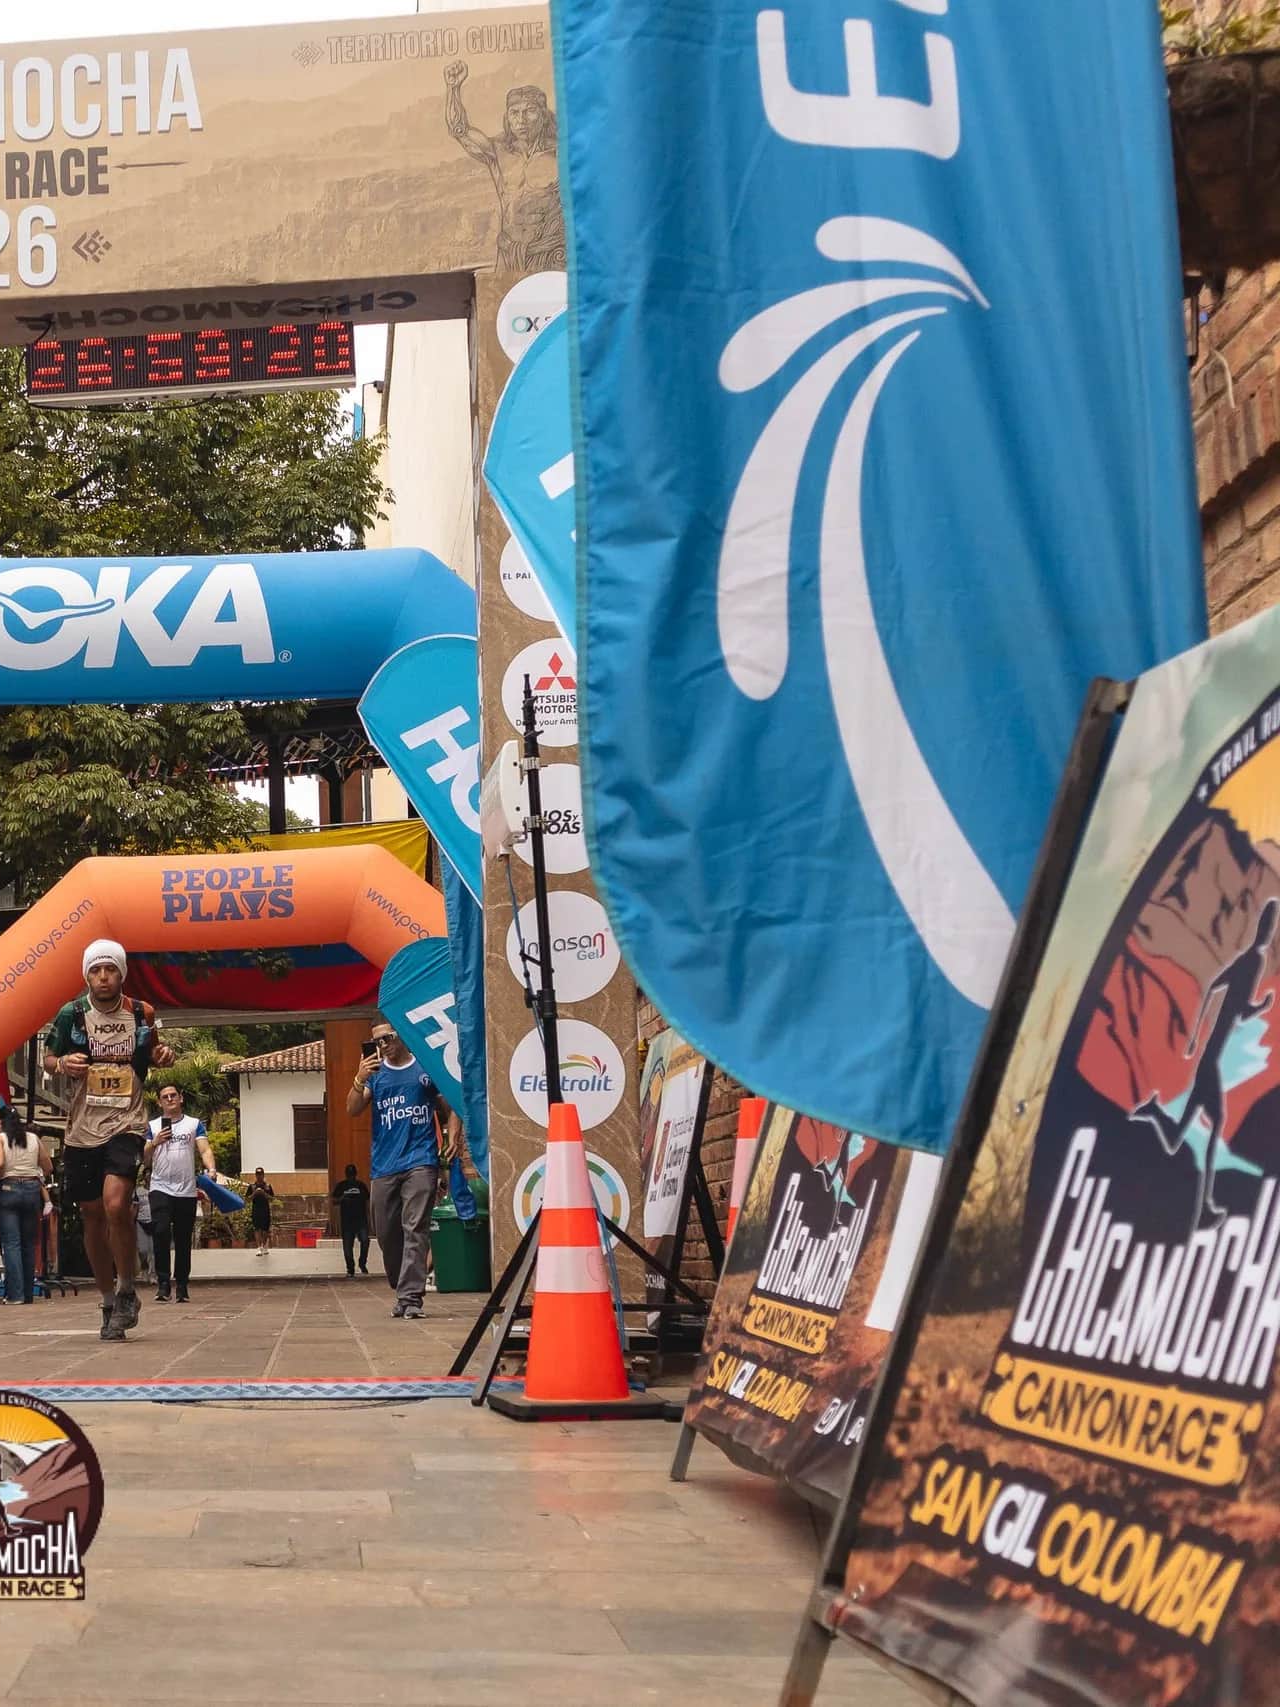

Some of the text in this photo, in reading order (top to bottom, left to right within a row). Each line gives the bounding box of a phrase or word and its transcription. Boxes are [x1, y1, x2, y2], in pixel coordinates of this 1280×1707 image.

[326, 21, 545, 65] TERRITORIO GUANE
[5, 145, 110, 199] RACE
[536, 695, 576, 704] TSUBIS
[400, 705, 482, 835] HO
[1211, 726, 1258, 786] TRAIL
[161, 865, 294, 892] PEOPLE
[162, 888, 296, 923] PLAYS
[367, 888, 429, 938] www.peo
[521, 932, 604, 958] Inasan
[577, 949, 599, 960] Gel
[89, 1035, 134, 1057] CHICAMOCHA
[94, 1023, 126, 1035] HOKA
[100, 1077, 120, 1089] 113
[520, 1074, 614, 1092] Eletrolit
[381, 1105, 429, 1130] nflasan
[757, 1172, 878, 1310] CHICAMOCHA
[1012, 1127, 1280, 1388] CHICAMOCHA
[754, 1303, 827, 1348] CANYON RACE
[744, 1367, 814, 1424] COLOMBIA
[1013, 1371, 1228, 1470] CANYON RACE
[1036, 1502, 1246, 1646] COLOMBIA
